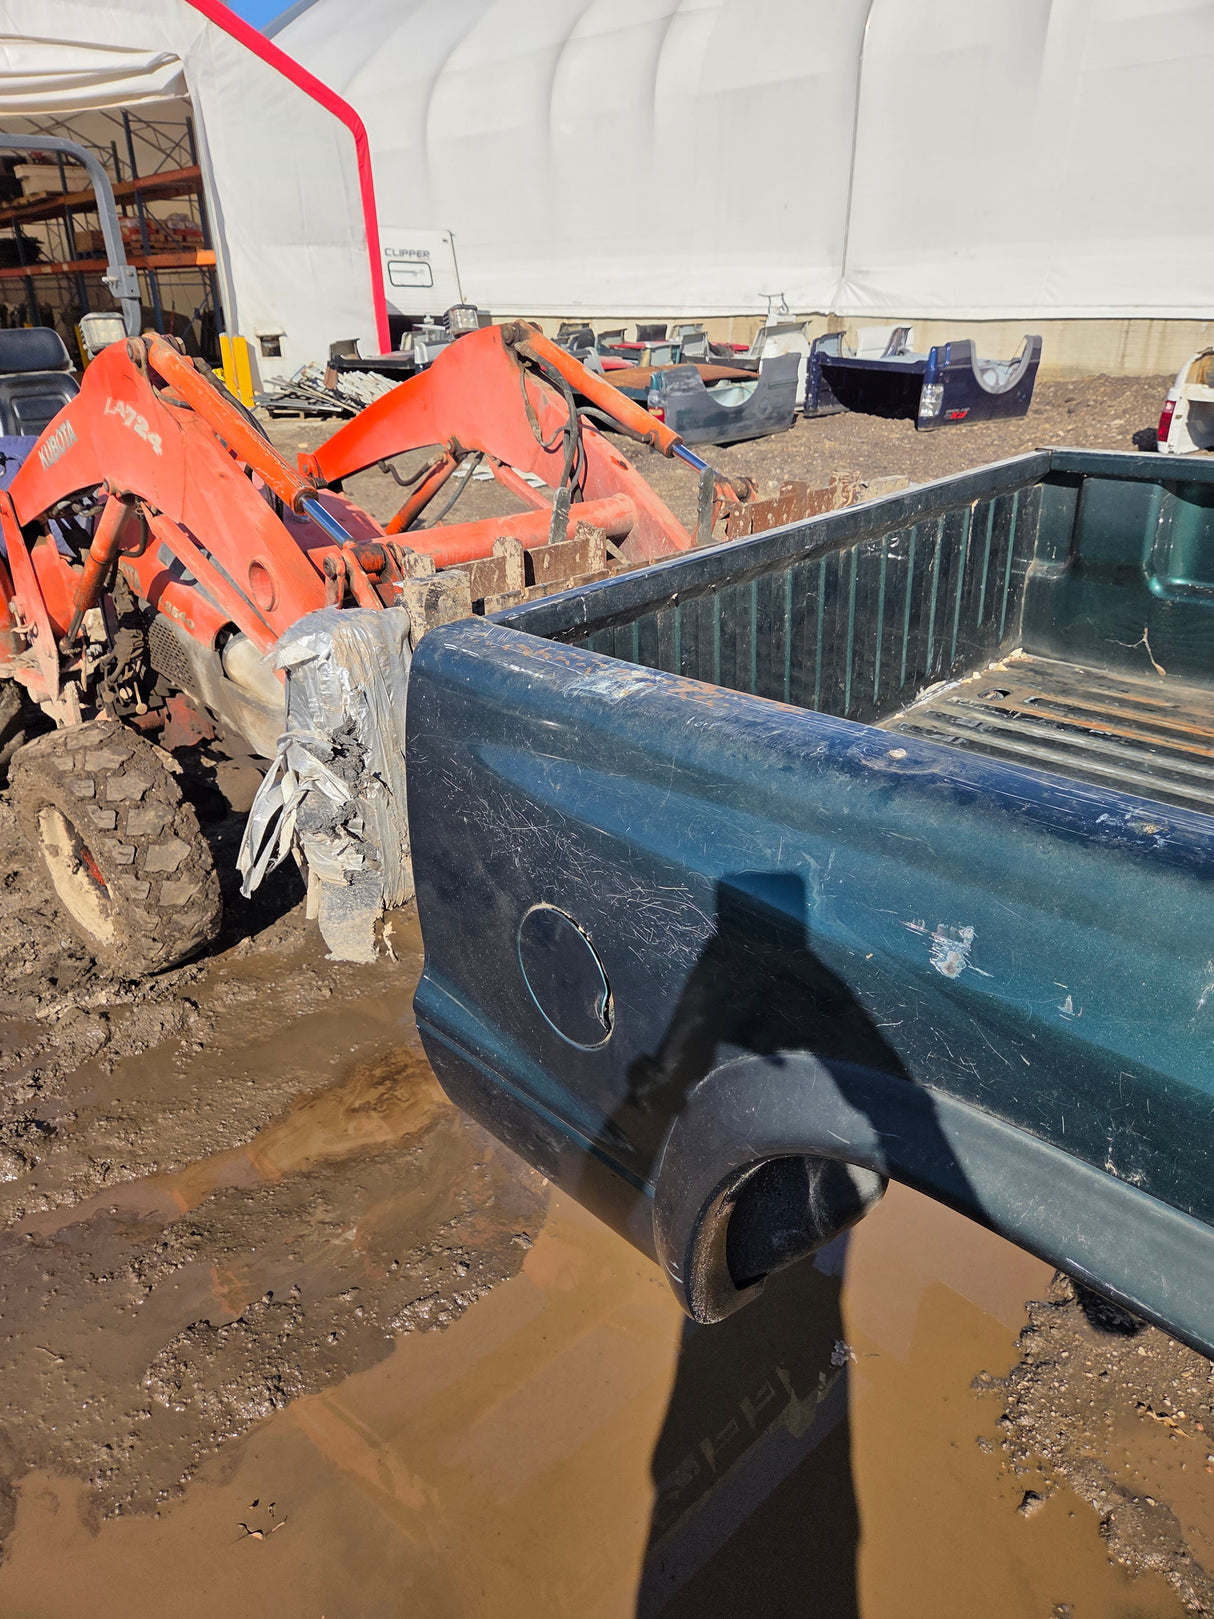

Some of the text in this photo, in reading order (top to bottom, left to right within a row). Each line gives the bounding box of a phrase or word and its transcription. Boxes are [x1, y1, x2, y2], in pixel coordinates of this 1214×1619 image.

[384, 247, 430, 258] CLIPPER
[38, 419, 78, 471] KUBOTA
[103, 397, 163, 456] LA724
